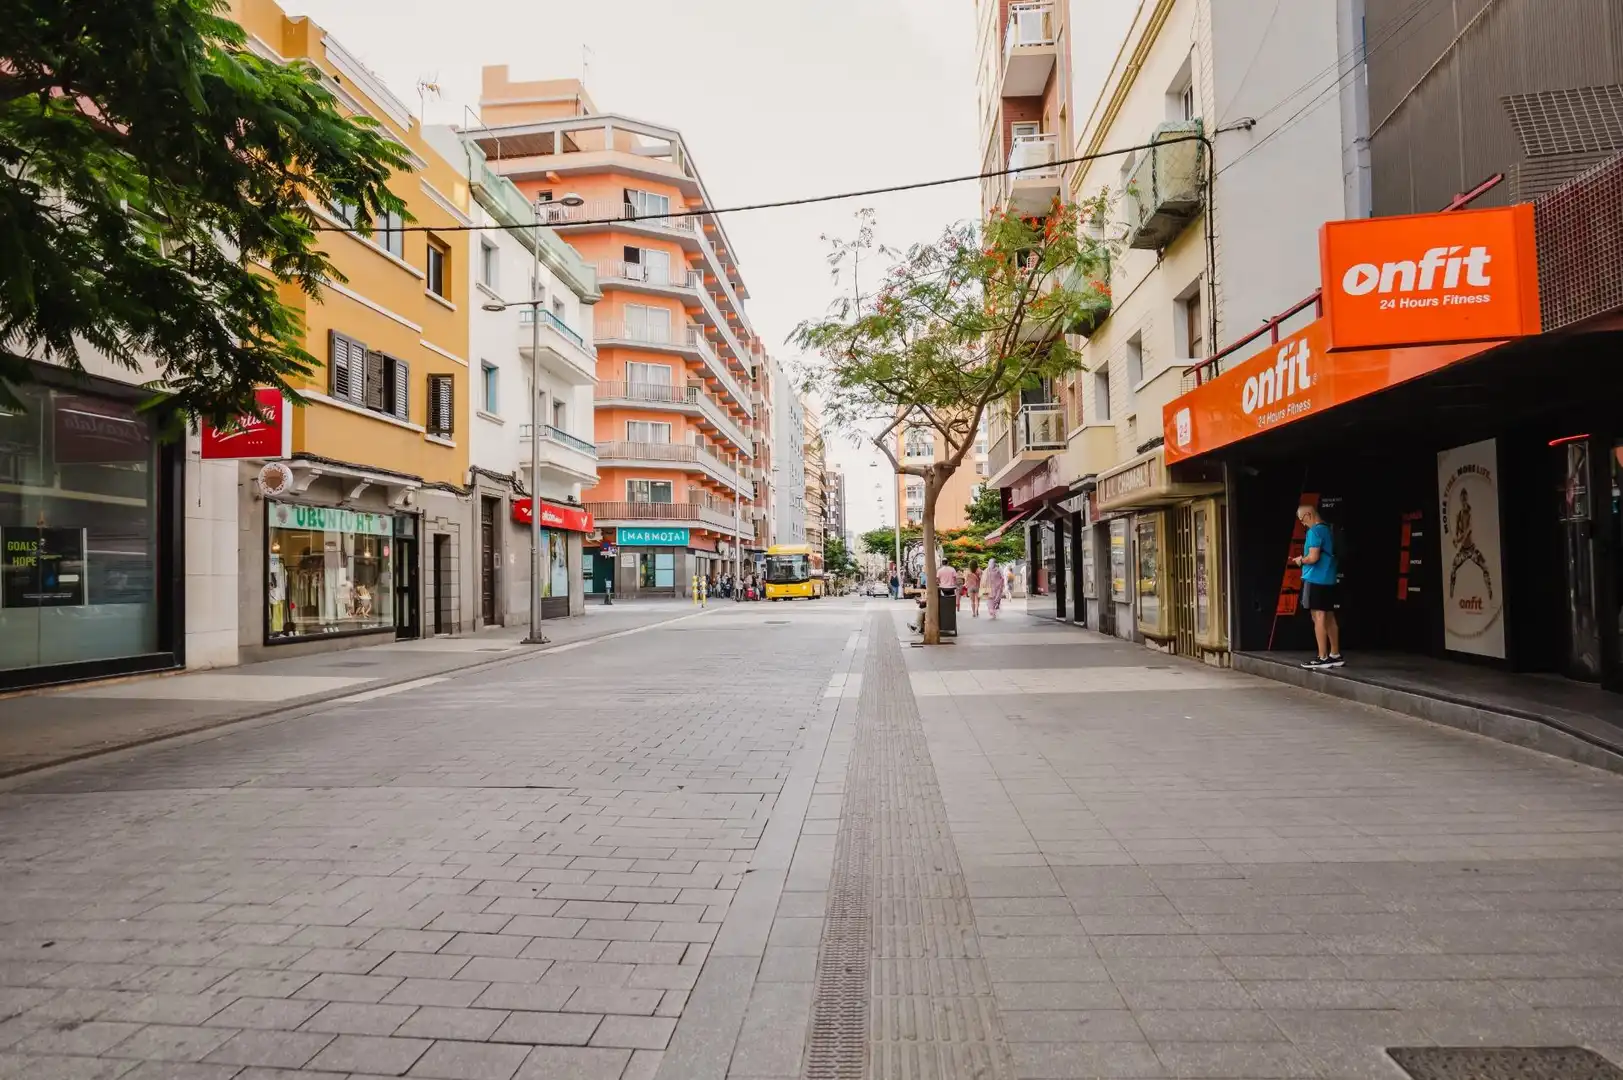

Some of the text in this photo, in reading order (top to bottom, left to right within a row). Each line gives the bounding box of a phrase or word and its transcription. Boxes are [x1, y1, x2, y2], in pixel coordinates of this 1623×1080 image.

[1342, 245, 1491, 296] onfit
[1380, 293, 1491, 310] 24 Hours Fitness
[1242, 338, 1311, 415] onfit
[1258, 398, 1312, 428] 24 Hours Fitness
[7, 541, 38, 551] GOALS
[12, 556, 38, 567] HOPE
[1459, 596, 1484, 610] onfit
